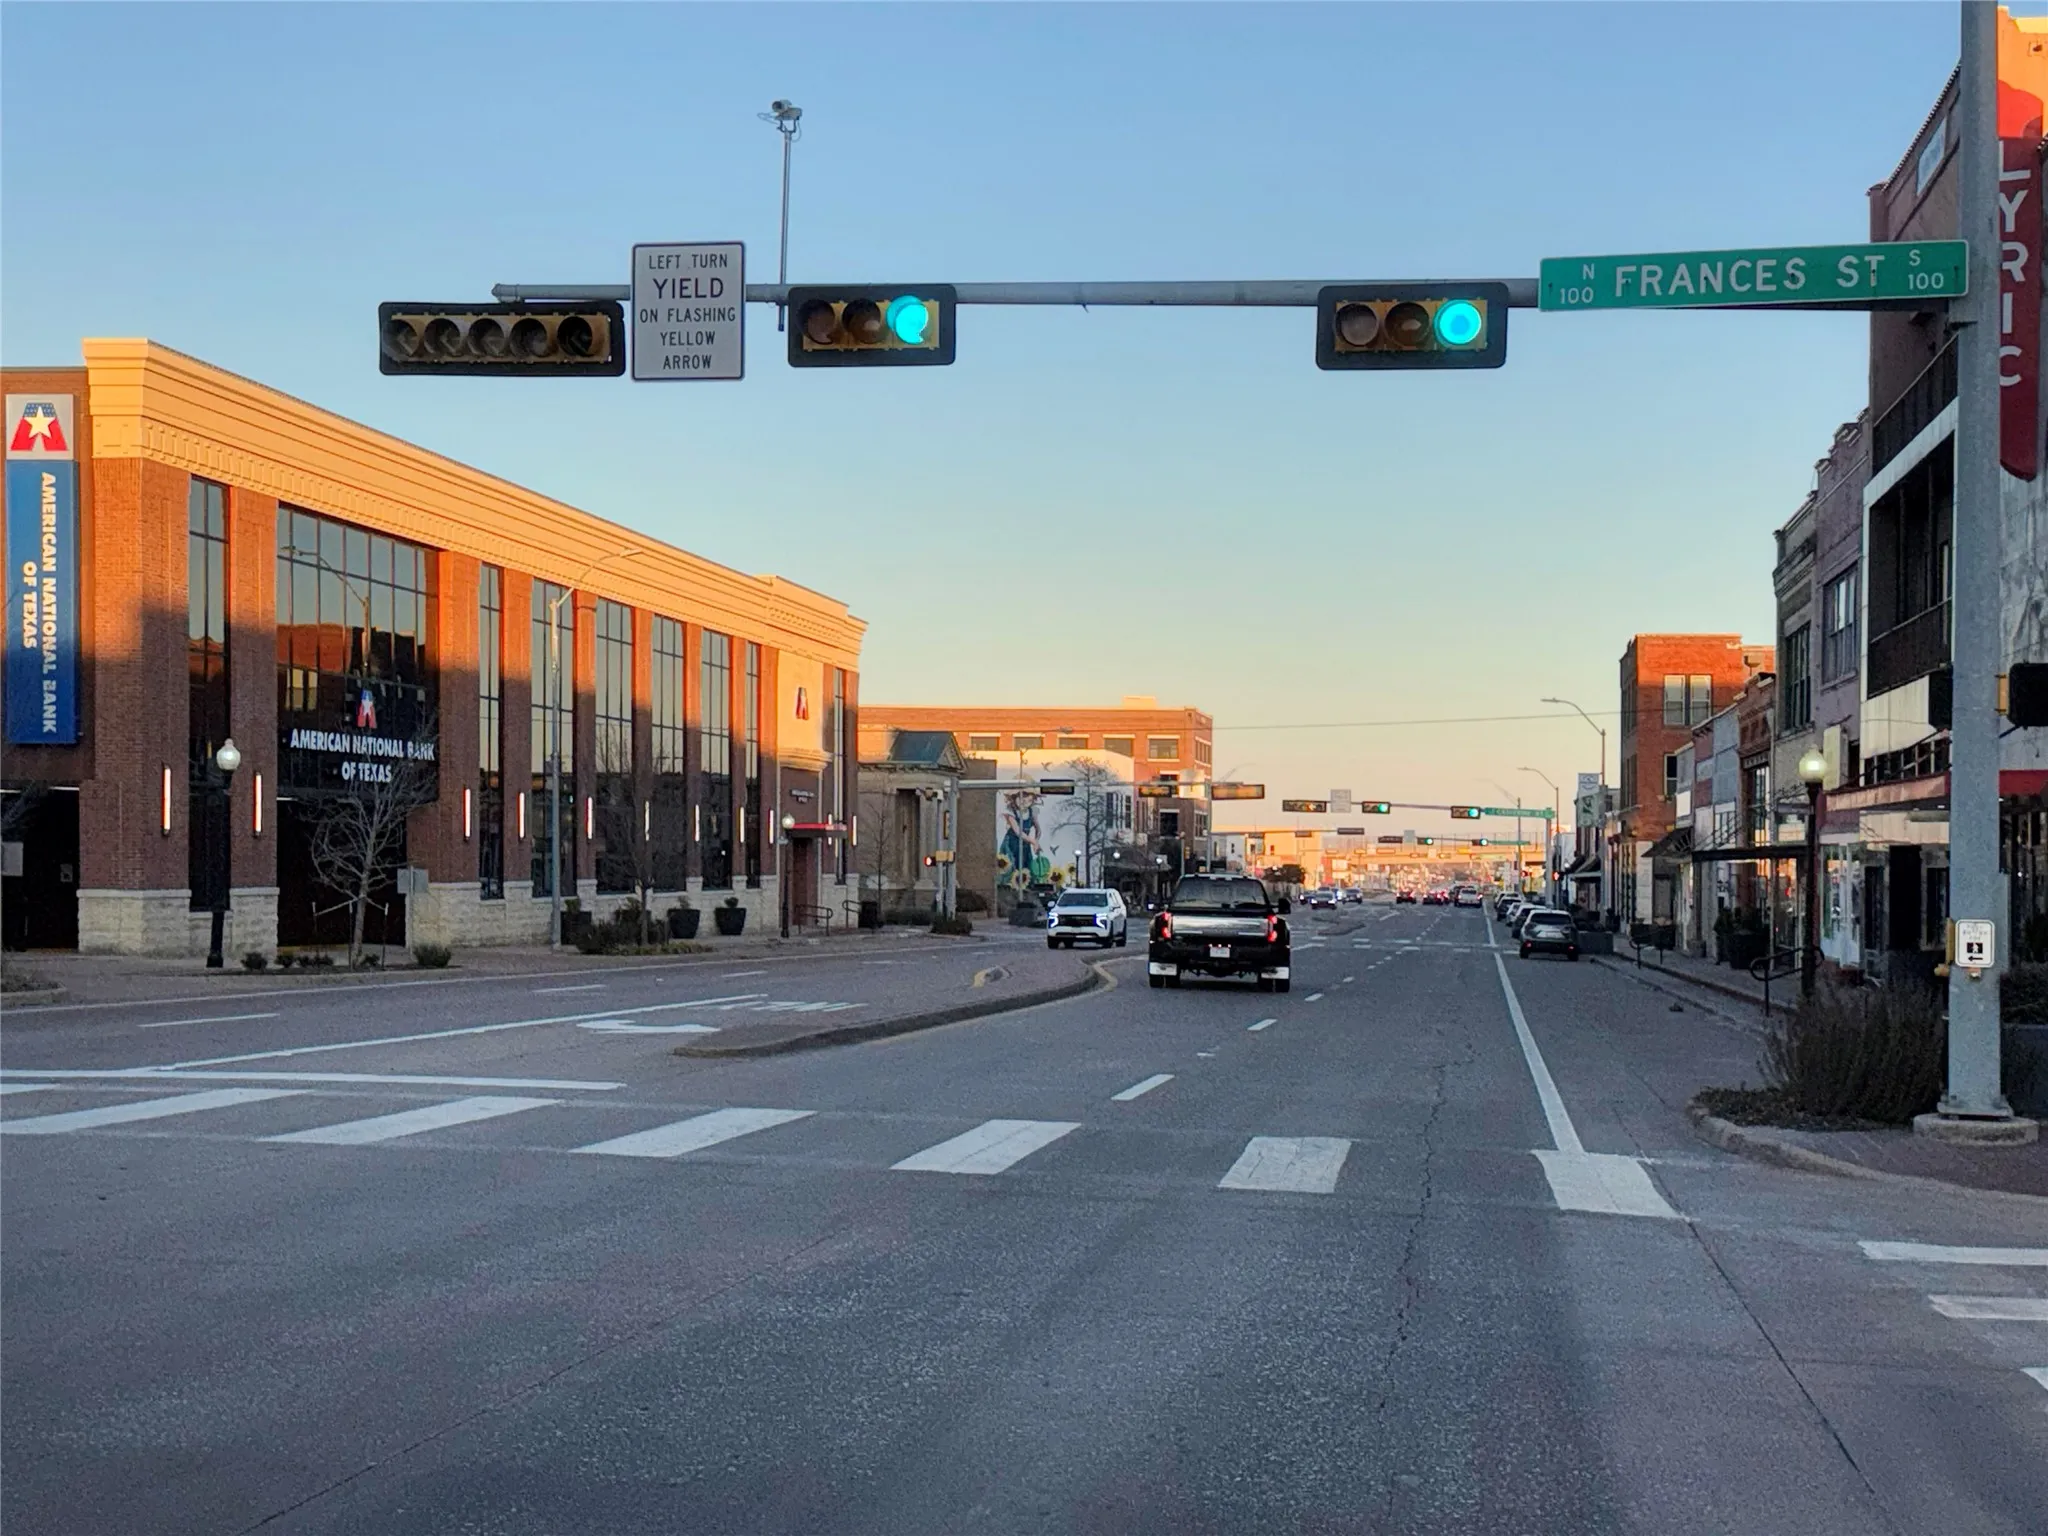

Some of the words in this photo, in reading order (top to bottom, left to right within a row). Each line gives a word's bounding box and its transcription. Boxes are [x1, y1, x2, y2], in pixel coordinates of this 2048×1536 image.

[649, 254, 681, 269] LEFT
[691, 253, 728, 268] TURN
[1909, 249, 1921, 266] S
[1999, 141, 2031, 387] LYRIC
[1582, 263, 1595, 280] N
[1615, 257, 1806, 298] FRANCES
[1836, 254, 1885, 288] ST
[1907, 272, 1945, 290] 100
[652, 277, 724, 299] YIELD
[1560, 286, 1594, 304] 100
[640, 308, 658, 323] ON
[667, 307, 736, 323] FLASHING
[660, 331, 716, 346] YELLOW
[663, 354, 712, 370] ARROW
[42, 472, 57, 571] AMERICAN
[23, 561, 38, 587] OF
[23, 591, 38, 649] TEXAS
[42, 577, 57, 674] NATIONAL
[42, 679, 57, 733] BANK
[290, 728, 350, 753] AMERICAN
[352, 735, 404, 758] NATIONAL
[407, 741, 435, 761] BANK
[341, 761, 356, 780] OF
[359, 762, 391, 782] TEXAS
